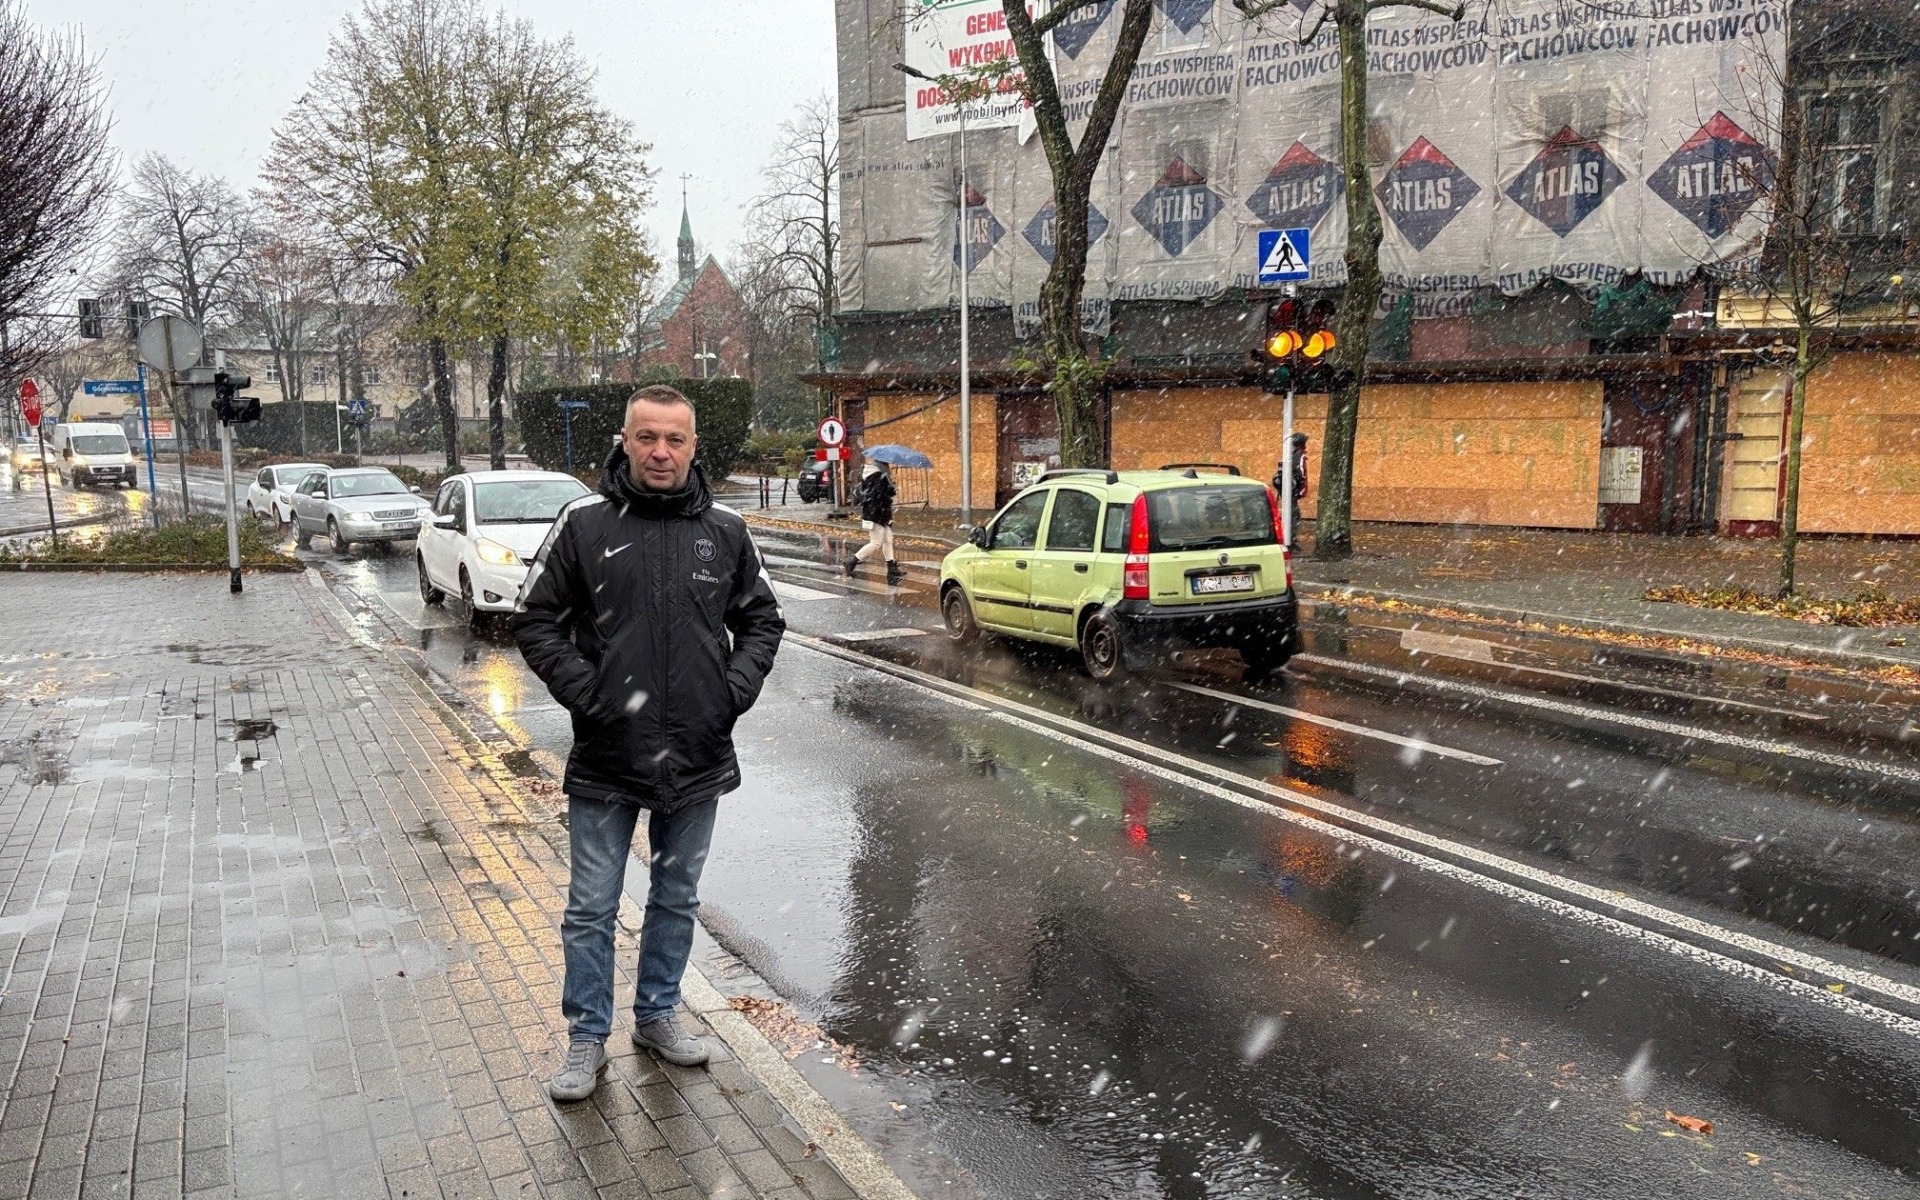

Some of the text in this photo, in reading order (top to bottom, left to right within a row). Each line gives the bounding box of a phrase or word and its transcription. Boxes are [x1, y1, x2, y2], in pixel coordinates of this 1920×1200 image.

[966, 9, 1008, 36] GENE
[1366, 19, 1488, 48] ATLAS WSPIERA
[1502, 1, 1637, 37] ATLAS WSPIERA
[948, 38, 1016, 68] WYKONA
[1246, 28, 1341, 63] ATLAS WSPIE
[1499, 23, 1638, 64] FACHOWCÓW
[1130, 54, 1235, 80] ATLAS WSPIERA
[1245, 46, 1341, 88] FACHOWCÓ
[1129, 73, 1234, 103] FACHOWCÓW
[1533, 161, 1599, 203] ATLAS
[1676, 156, 1754, 199] ATLAS
[1151, 192, 1205, 225] ATLAS
[1268, 175, 1326, 216] ATLAS
[1392, 177, 1452, 212] ATLAS
[1119, 280, 1220, 300] ATLAS WSPIERA
[1499, 266, 1548, 292] ATLAS
[23, 394, 39, 411] STOP
[692, 572, 719, 583] Emirates
